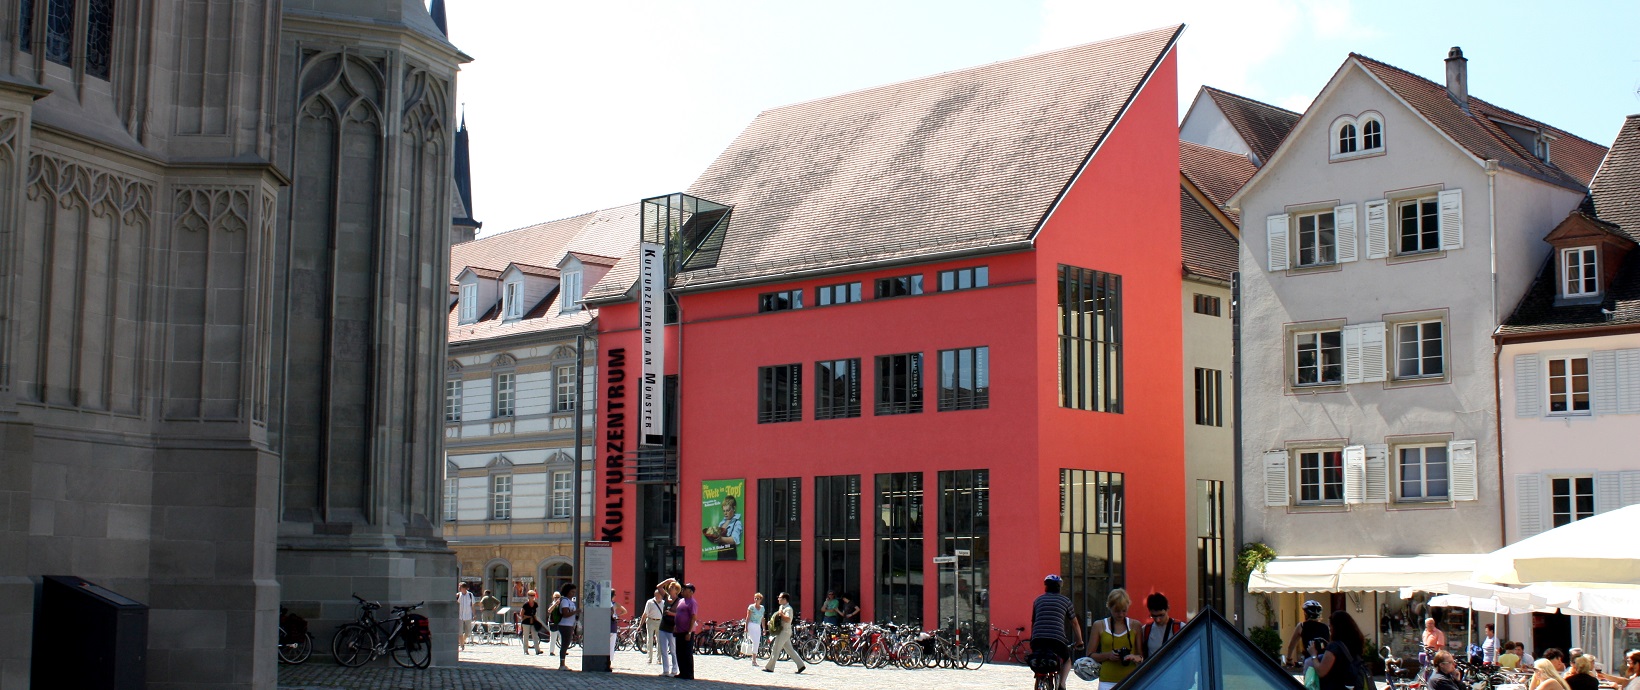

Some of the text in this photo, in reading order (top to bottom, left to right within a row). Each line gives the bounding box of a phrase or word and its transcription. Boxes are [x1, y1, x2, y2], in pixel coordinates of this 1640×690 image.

[645, 249, 656, 428] KULTURZENTRUM AM MÜNSTER
[602, 348, 625, 543] KULTURZENTRUM
[703, 488, 720, 499] Welt
[725, 482, 742, 498] Topf
